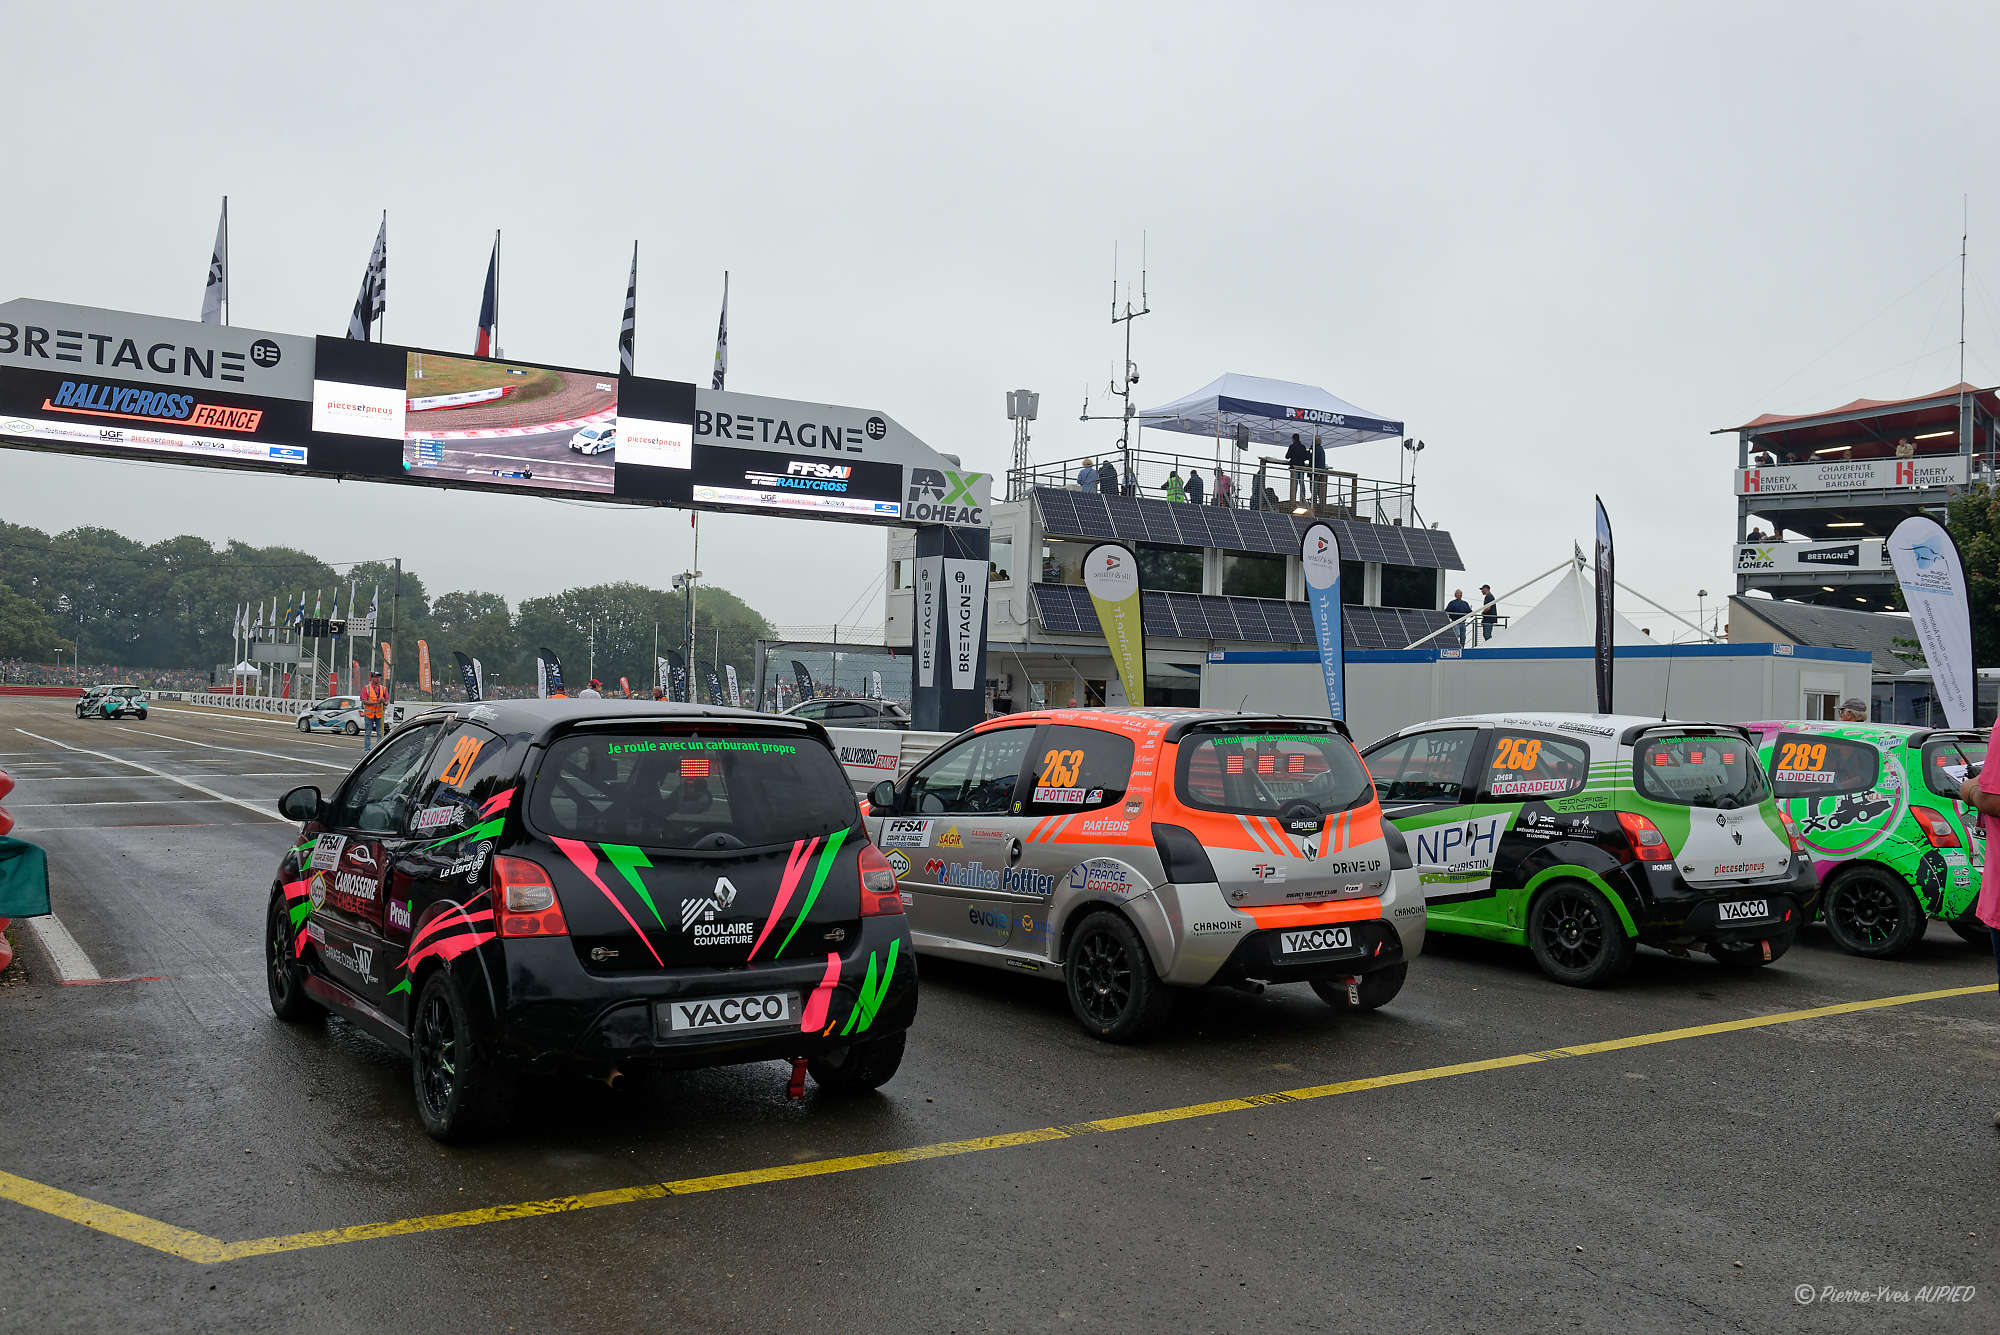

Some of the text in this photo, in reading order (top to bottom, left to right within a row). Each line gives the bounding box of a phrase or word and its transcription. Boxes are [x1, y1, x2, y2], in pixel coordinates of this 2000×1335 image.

[0, 322, 246, 382] BRETAGNE
[54, 381, 259, 430] RALLYCROSS FRANCE
[327, 401, 393, 416] piecesetpneus
[695, 410, 863, 453] BRETAGNE
[787, 461, 850, 479] FFSA
[1818, 471, 1876, 481] COUVERTURE
[1821, 464, 1872, 473] CHARPENTE
[776, 478, 848, 492] RALLYCROSS
[1825, 480, 1867, 488] BARDAGE
[905, 502, 983, 524] LOHEAC
[1807, 551, 1850, 561] BRETAGNE
[1737, 561, 1775, 569] LOHEAC
[923, 581, 932, 670] BRETAGNE
[958, 583, 972, 673] BRETAGNE
[608, 739, 796, 756] Je roule avec un carburant propre
[840, 746, 878, 765] RALLYCROSS
[1492, 738, 1542, 771] 268
[1778, 743, 1827, 771] 289
[1037, 749, 1084, 788] 263
[1777, 772, 1832, 783] A.DIDELOT
[1035, 789, 1083, 801] L.POTTIER
[1493, 780, 1566, 794] M.CARADEUX
[1558, 802, 1608, 811] RACING
[420, 808, 453, 828] S.LOYER
[890, 820, 924, 832] FFSA
[1291, 819, 1317, 829] eleven
[940, 833, 961, 845] SAGIR
[1417, 820, 1497, 866] NPH
[440, 861, 473, 878] Le Liard
[1367, 859, 1381, 872] UP
[1448, 859, 1489, 872] CHRISTIN
[1714, 861, 1765, 876] piecesetpneus
[950, 861, 999, 889] Mailhes
[1002, 867, 1054, 896] Pottier
[1089, 868, 1127, 882] FRANCE
[335, 870, 378, 900] CARROSSERIE
[390, 901, 411, 929] Proxi
[1394, 905, 1425, 917] CHANOINE
[1723, 902, 1766, 919] YACCO
[693, 922, 754, 935] BOULAIRE
[1193, 919, 1242, 932] CHANOINE
[693, 934, 753, 946] COUVERTURE
[1286, 928, 1348, 952] YACCO
[680, 996, 783, 1027] YACCO
